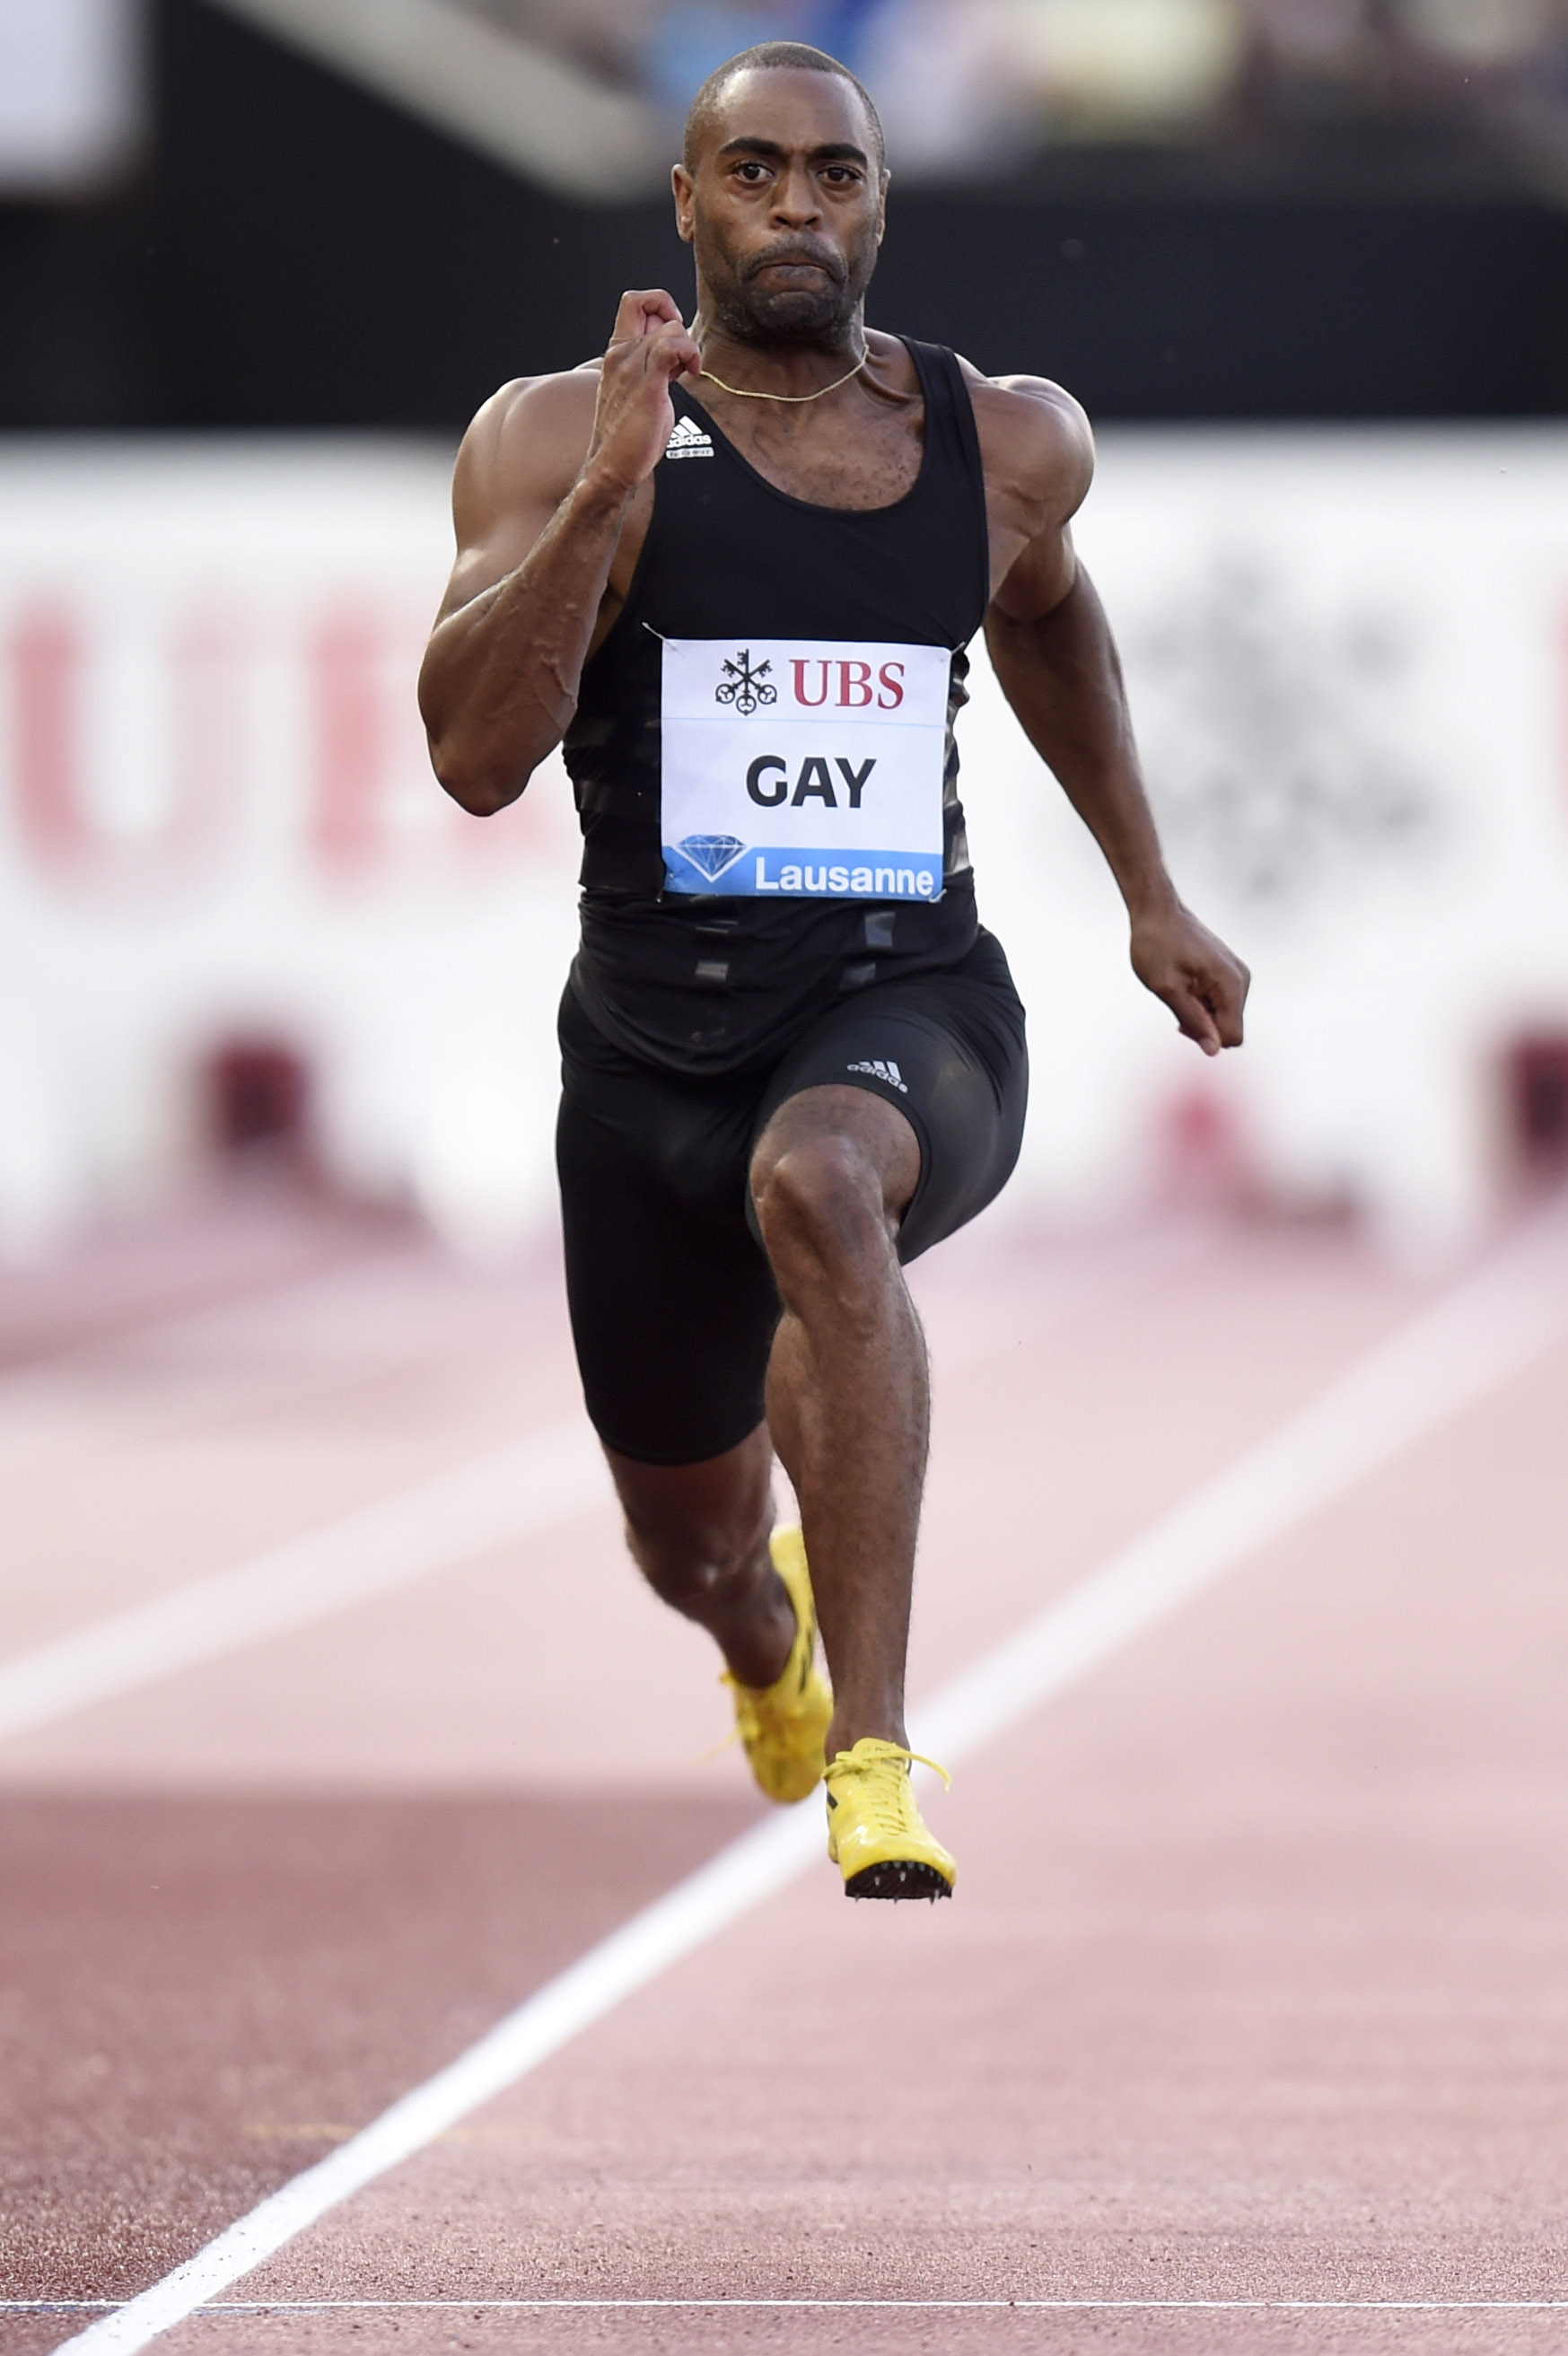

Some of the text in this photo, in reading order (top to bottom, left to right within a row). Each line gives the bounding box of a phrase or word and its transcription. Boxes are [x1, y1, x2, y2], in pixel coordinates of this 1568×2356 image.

[789, 659, 906, 710] UBS
[746, 755, 877, 809] GAY
[755, 856, 934, 894] Lausanne
[846, 1063, 908, 1093] adidas
